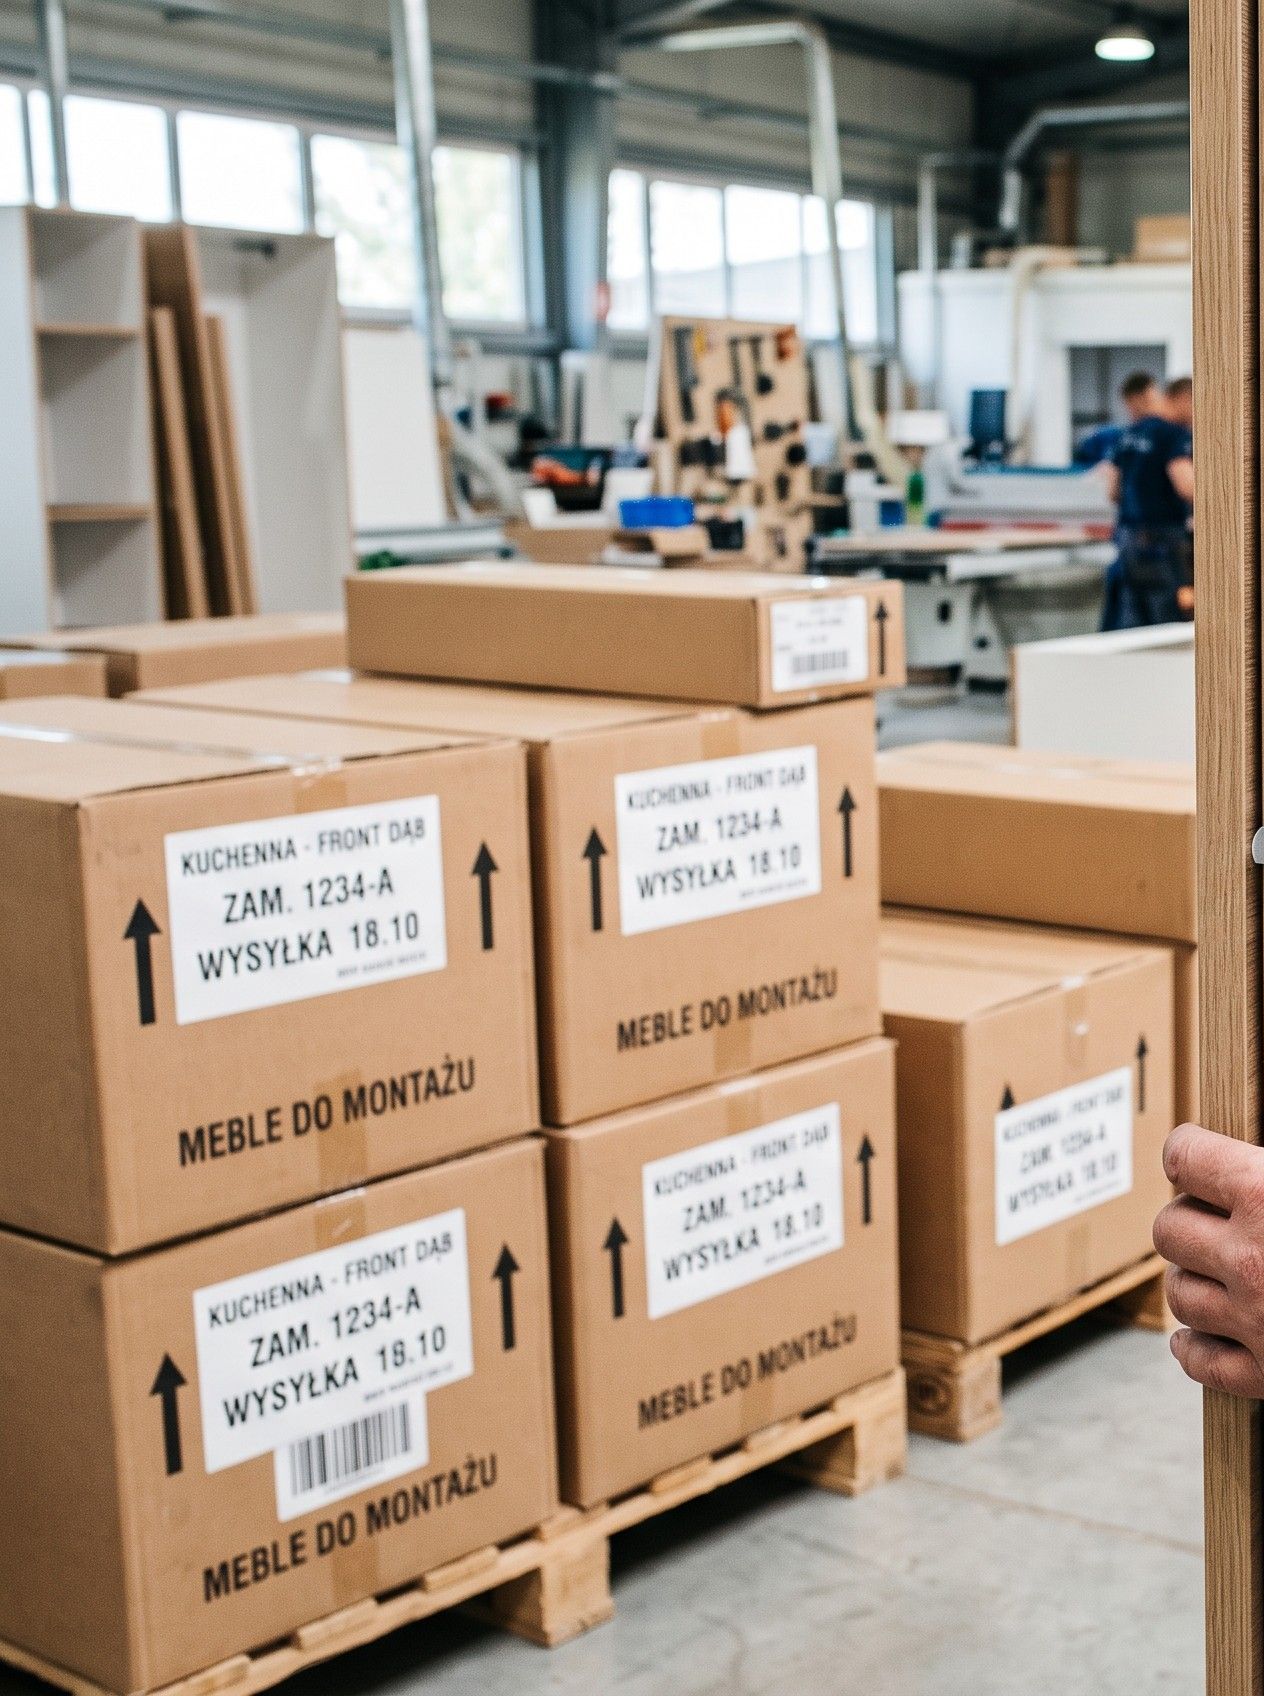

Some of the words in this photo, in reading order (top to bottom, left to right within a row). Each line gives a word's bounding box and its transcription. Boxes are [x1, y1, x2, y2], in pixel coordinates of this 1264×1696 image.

[181, 837, 298, 877] KUCHENNA
[317, 822, 381, 855] FRONT
[389, 817, 426, 848] DĄB
[716, 806, 783, 840] 1234-A
[223, 885, 294, 924] ZAM.
[304, 867, 395, 909] 1234-A
[197, 929, 333, 982] WYSYŁKA
[350, 912, 420, 951] 18.10
[616, 1004, 694, 1053] MEBLE
[699, 995, 733, 1032] DO
[737, 966, 839, 1020] MONTAŻU
[178, 1106, 283, 1168] MEBLE
[291, 1093, 335, 1138] DO
[342, 1054, 478, 1125] MONTAŻU
[207, 1274, 325, 1329] KUCHENNA
[344, 1245, 408, 1285] FRONT
[416, 1231, 453, 1265] DĄB
[250, 1323, 320, 1369] ZAM.
[330, 1285, 422, 1340] 1234-A
[222, 1356, 359, 1430] WYSYŁKA
[377, 1325, 447, 1373] 18.10
[637, 1370, 714, 1431] MEBLE
[720, 1359, 752, 1397] DO
[756, 1312, 858, 1381] MONTAŻU
[202, 1528, 308, 1603] MEBLE
[316, 1512, 358, 1559] DO
[366, 1452, 499, 1537] MONTAŻU
